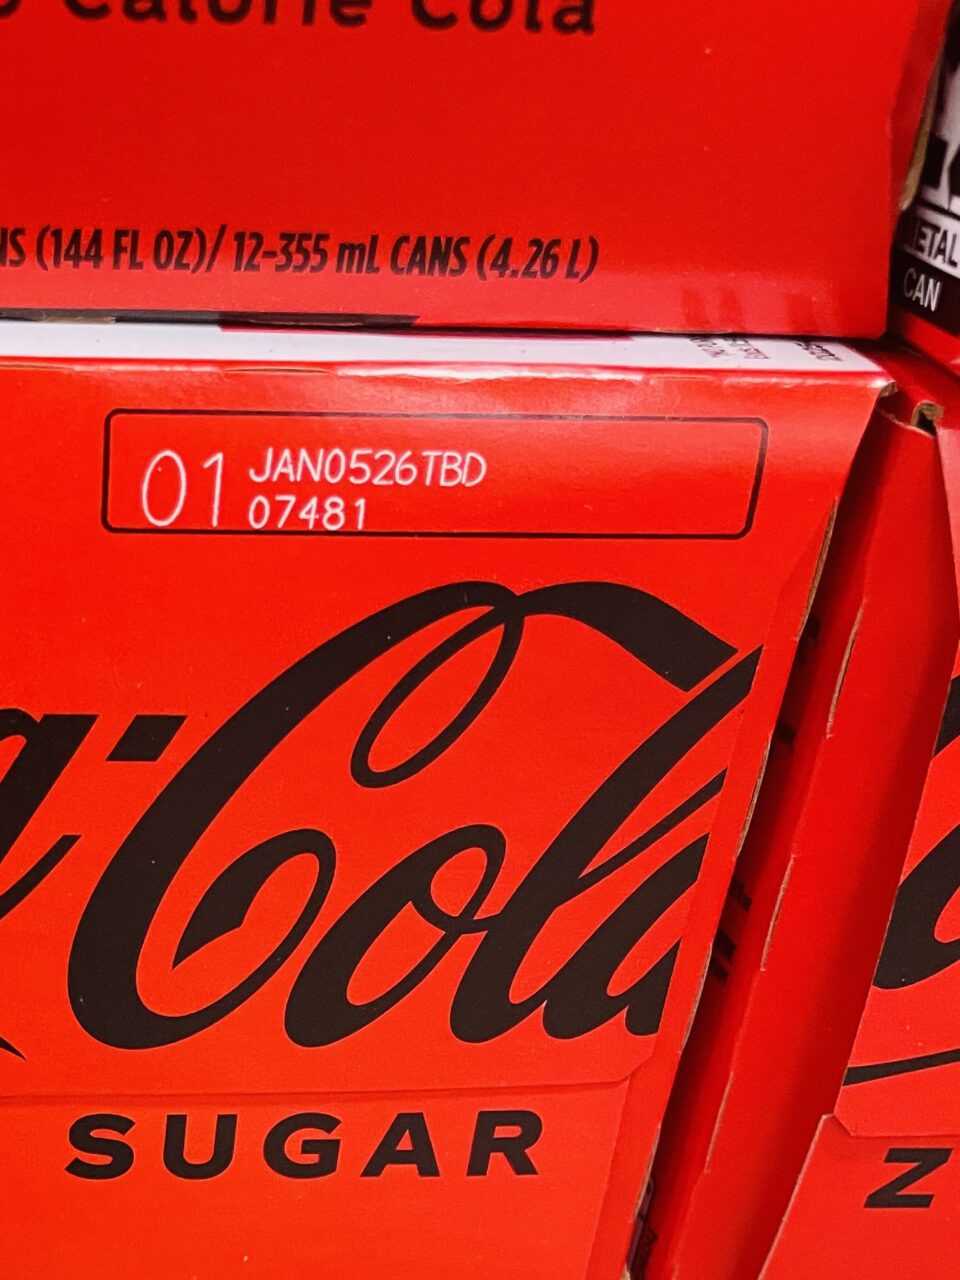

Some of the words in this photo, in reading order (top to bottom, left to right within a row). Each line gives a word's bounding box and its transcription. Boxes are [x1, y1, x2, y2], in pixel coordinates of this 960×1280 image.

[411, 0, 595, 35] Cola
[36, 224, 104, 272] (144
[113, 229, 144, 270] FL
[233, 231, 331, 274] 12-355
[336, 234, 381, 275] mL
[390, 235, 471, 278] CANS
[912, 220, 959, 269] ETAL
[903, 267, 942, 312] CAN
[141, 449, 225, 528] 01
[249, 447, 488, 488] JAN0526TBD
[248, 495, 367, 531] 07481
[64, 1109, 544, 1181] SUGAR
